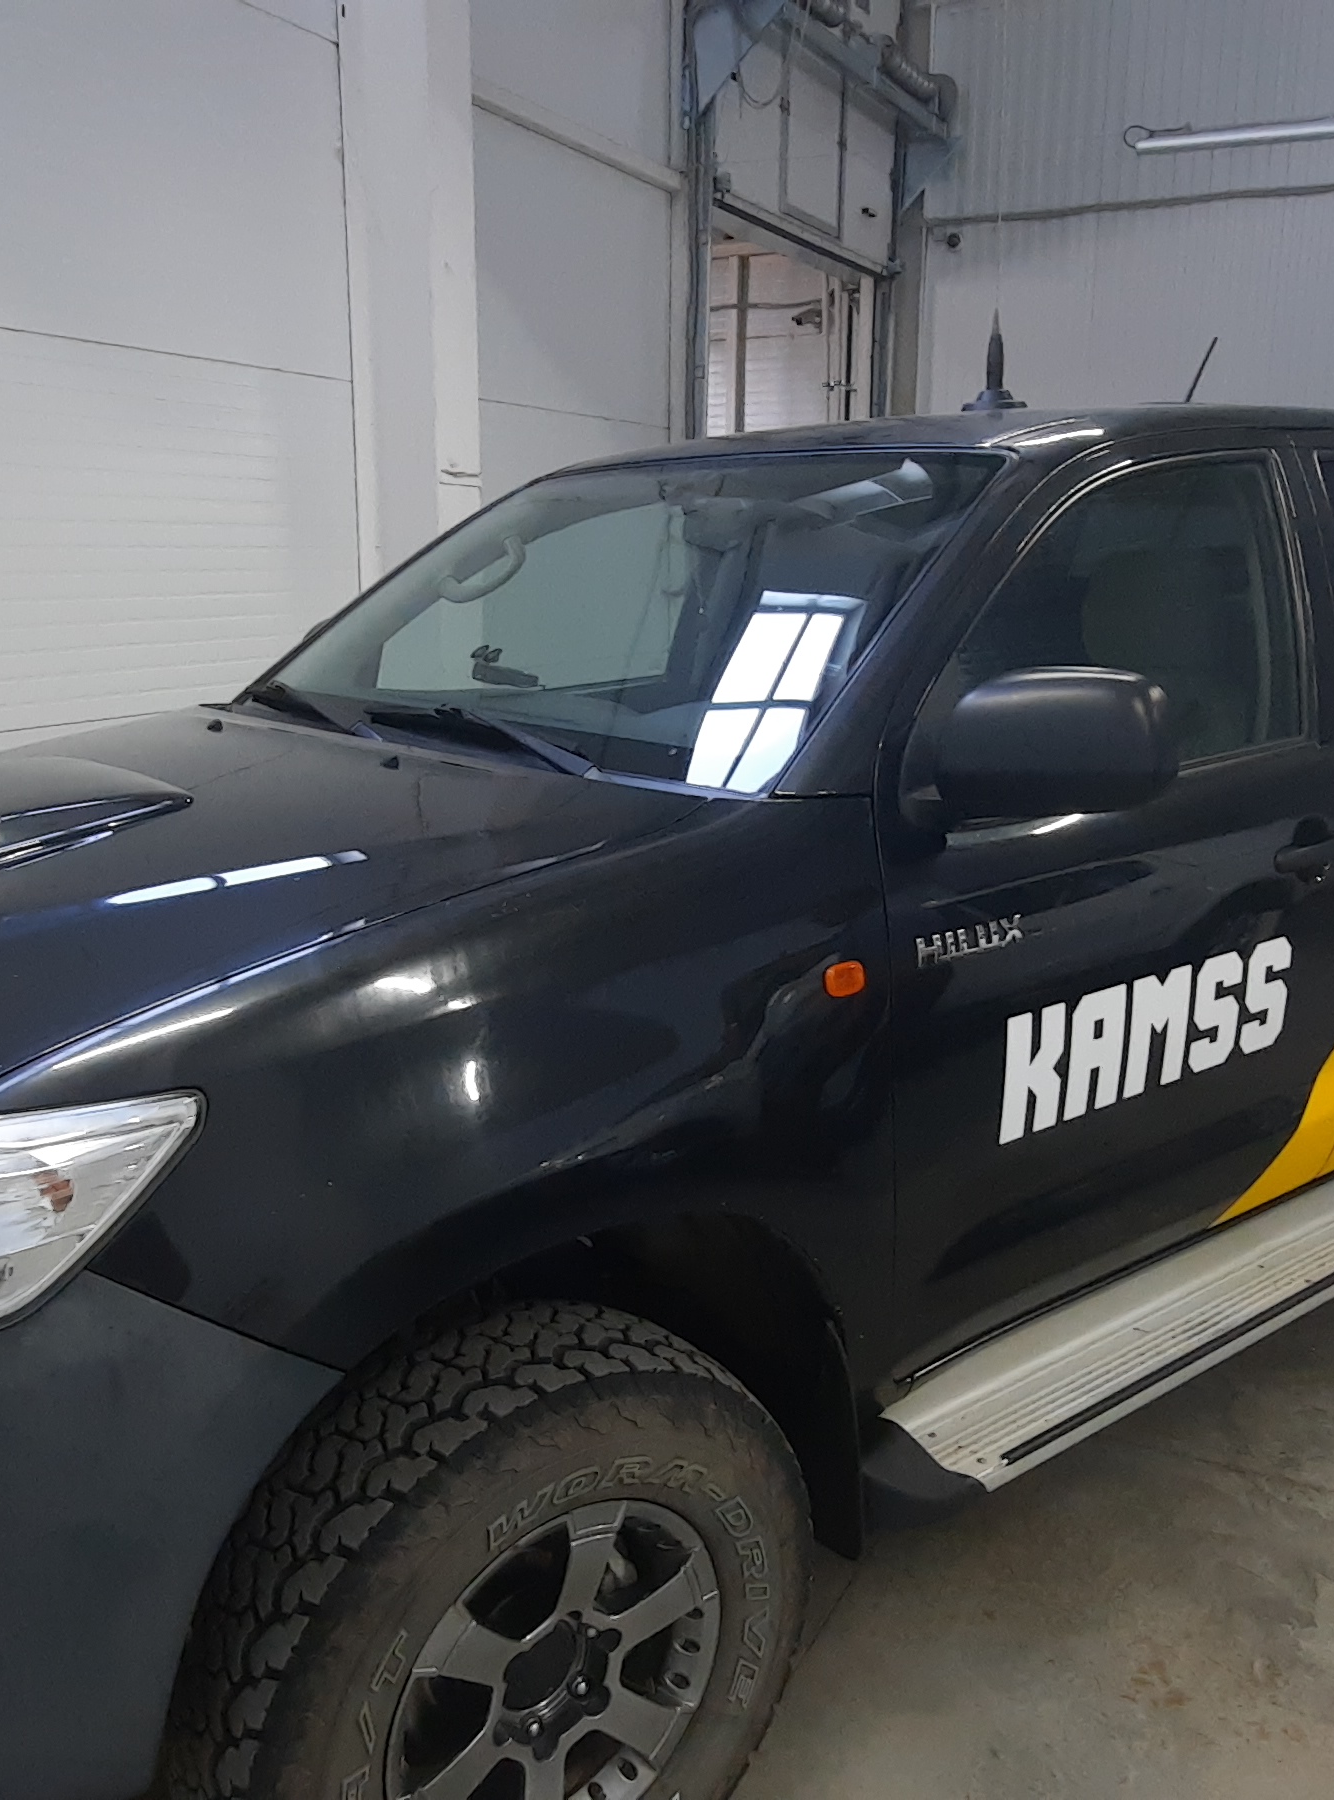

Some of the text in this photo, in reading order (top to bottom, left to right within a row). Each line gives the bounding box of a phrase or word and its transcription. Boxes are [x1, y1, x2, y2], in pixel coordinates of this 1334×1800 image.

[915, 912, 1023, 968] HILUX
[998, 935, 1294, 1147] KAMSS
[485, 1453, 771, 1709] WORM-DRIVE
